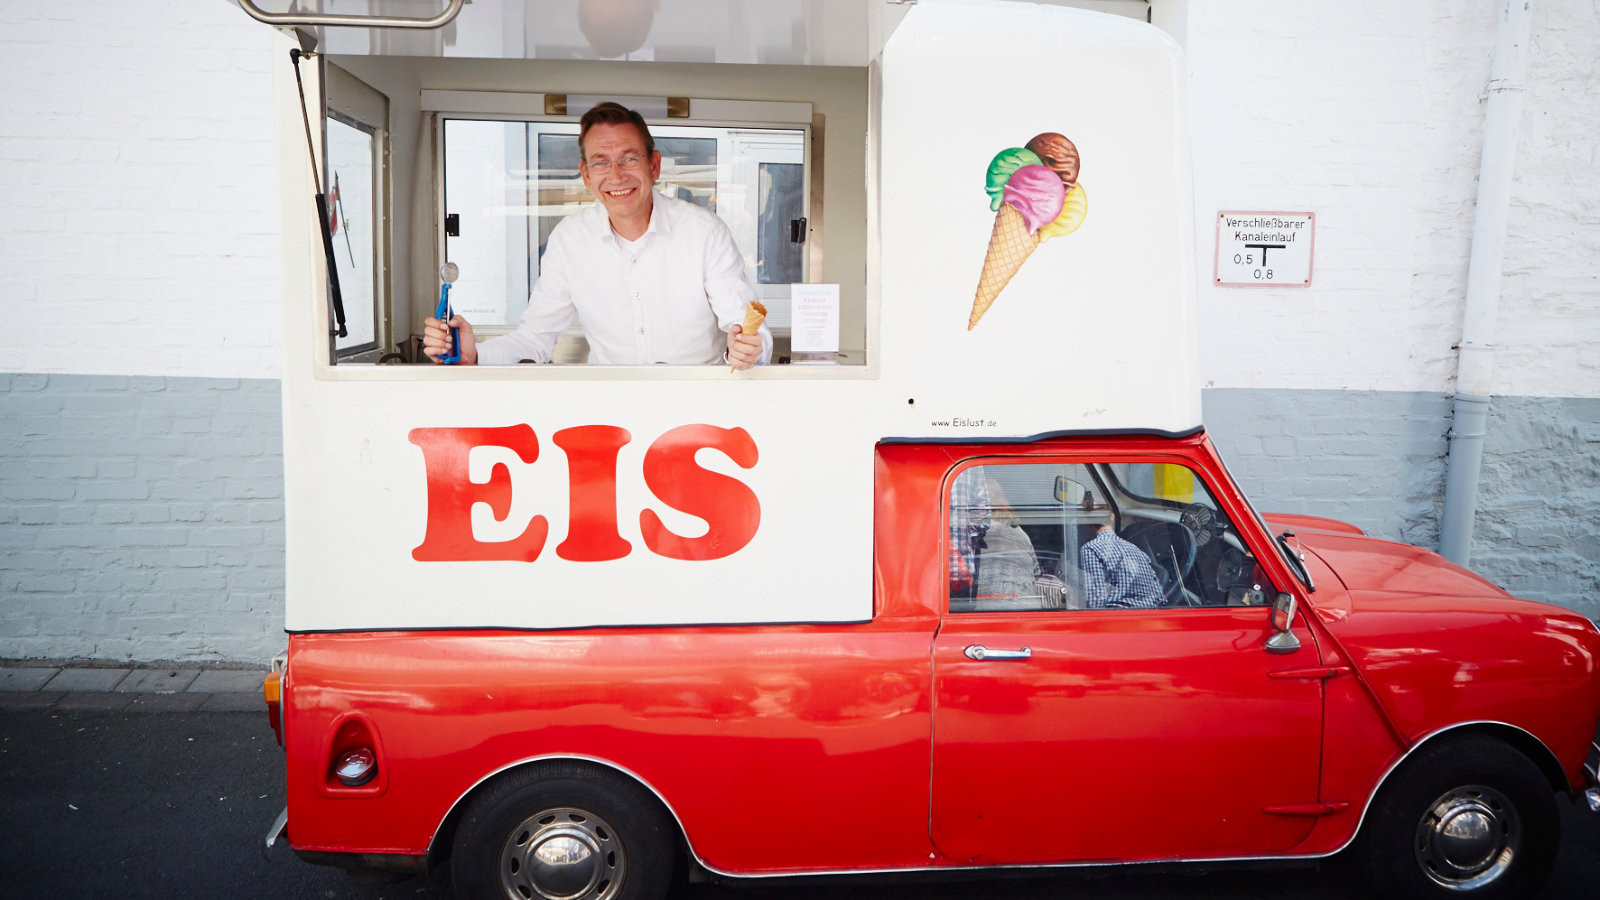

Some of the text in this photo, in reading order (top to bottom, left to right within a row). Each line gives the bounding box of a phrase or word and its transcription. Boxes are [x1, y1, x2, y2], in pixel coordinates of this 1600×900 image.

[1226, 217, 1305, 229] Verschließbarer
[1234, 231, 1296, 242] Kanaleinlauf
[1233, 253, 1254, 265] 0,5
[1253, 269, 1274, 280] 0,8
[931, 417, 997, 428] www.Eislust.de
[409, 423, 761, 562] EIS
